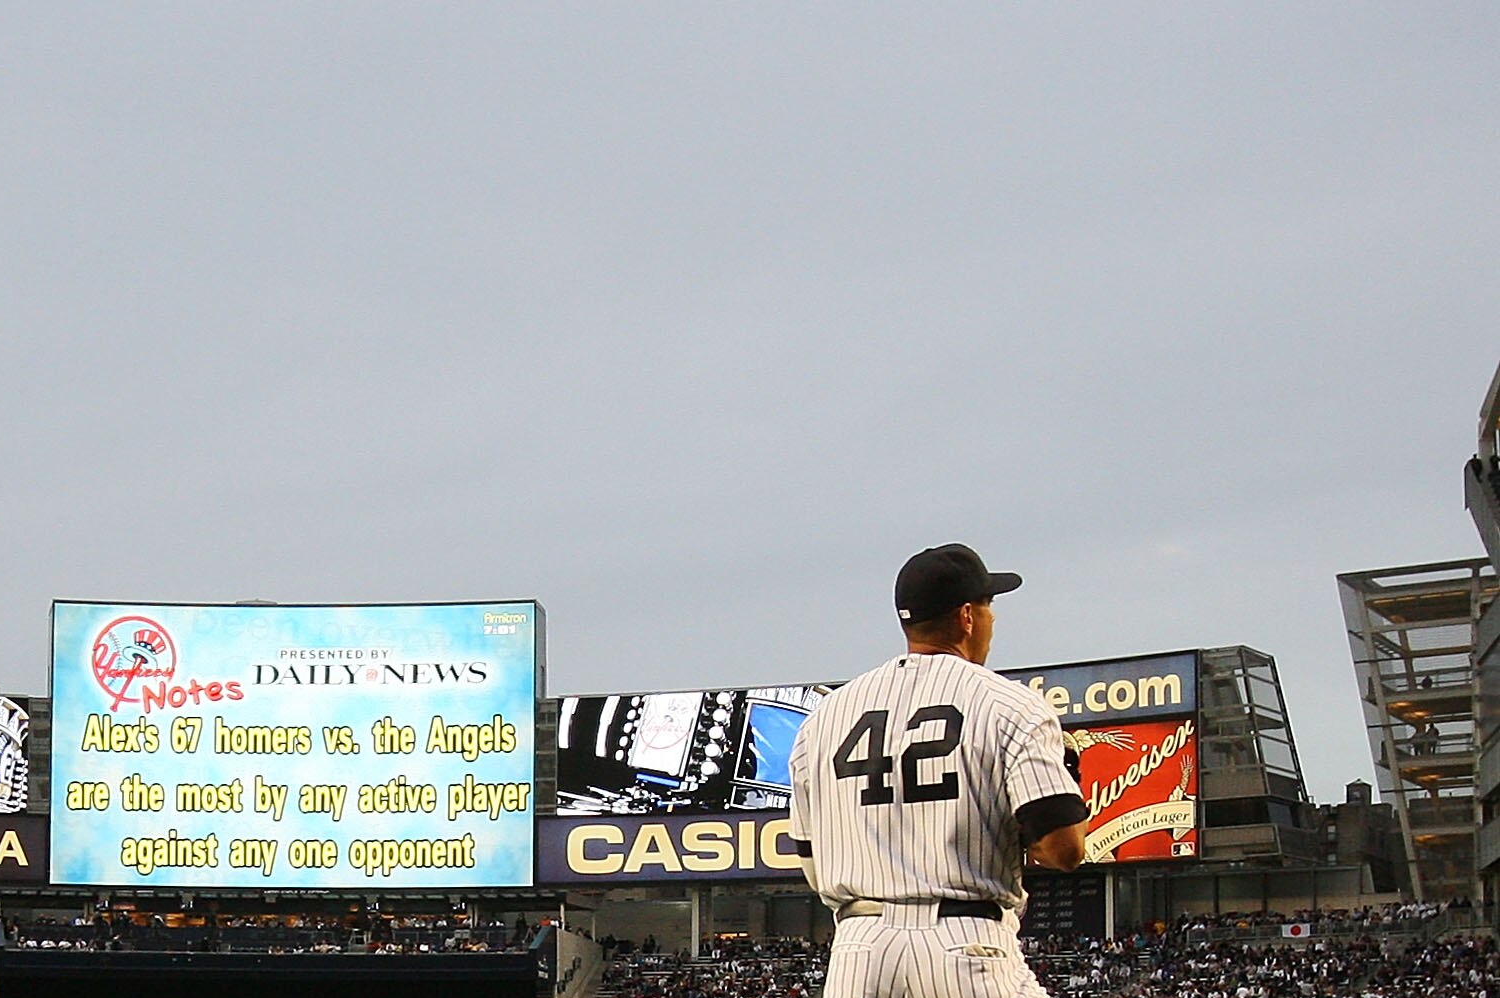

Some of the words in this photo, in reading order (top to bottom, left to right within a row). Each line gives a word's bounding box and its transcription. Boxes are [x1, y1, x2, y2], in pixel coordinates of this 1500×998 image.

[253, 664, 364, 685] DAILY
[382, 661, 487, 684] NEWS
[280, 650, 363, 659] PRESENTED
[371, 650, 389, 659] BY
[143, 679, 244, 714] Notes
[82, 714, 159, 753] Alex's
[171, 717, 202, 753] 67
[214, 716, 312, 754] homers
[322, 726, 360, 755] vs.
[372, 716, 416, 754] the
[426, 714, 516, 762] Angels
[833, 704, 964, 806] 42
[1086, 719, 1195, 821] dweiser
[66, 781, 110, 811] are
[120, 773, 165, 812] the
[176, 778, 243, 813] most
[254, 775, 288, 821] by
[298, 784, 347, 822] any
[358, 775, 437, 813] active
[448, 774, 531, 821] player
[121, 829, 219, 876] against
[228, 839, 279, 876] any
[288, 839, 338, 869] one
[349, 832, 475, 877] opponent
[1092, 817, 1149, 855] American
[1153, 811, 1190, 825] Lager
